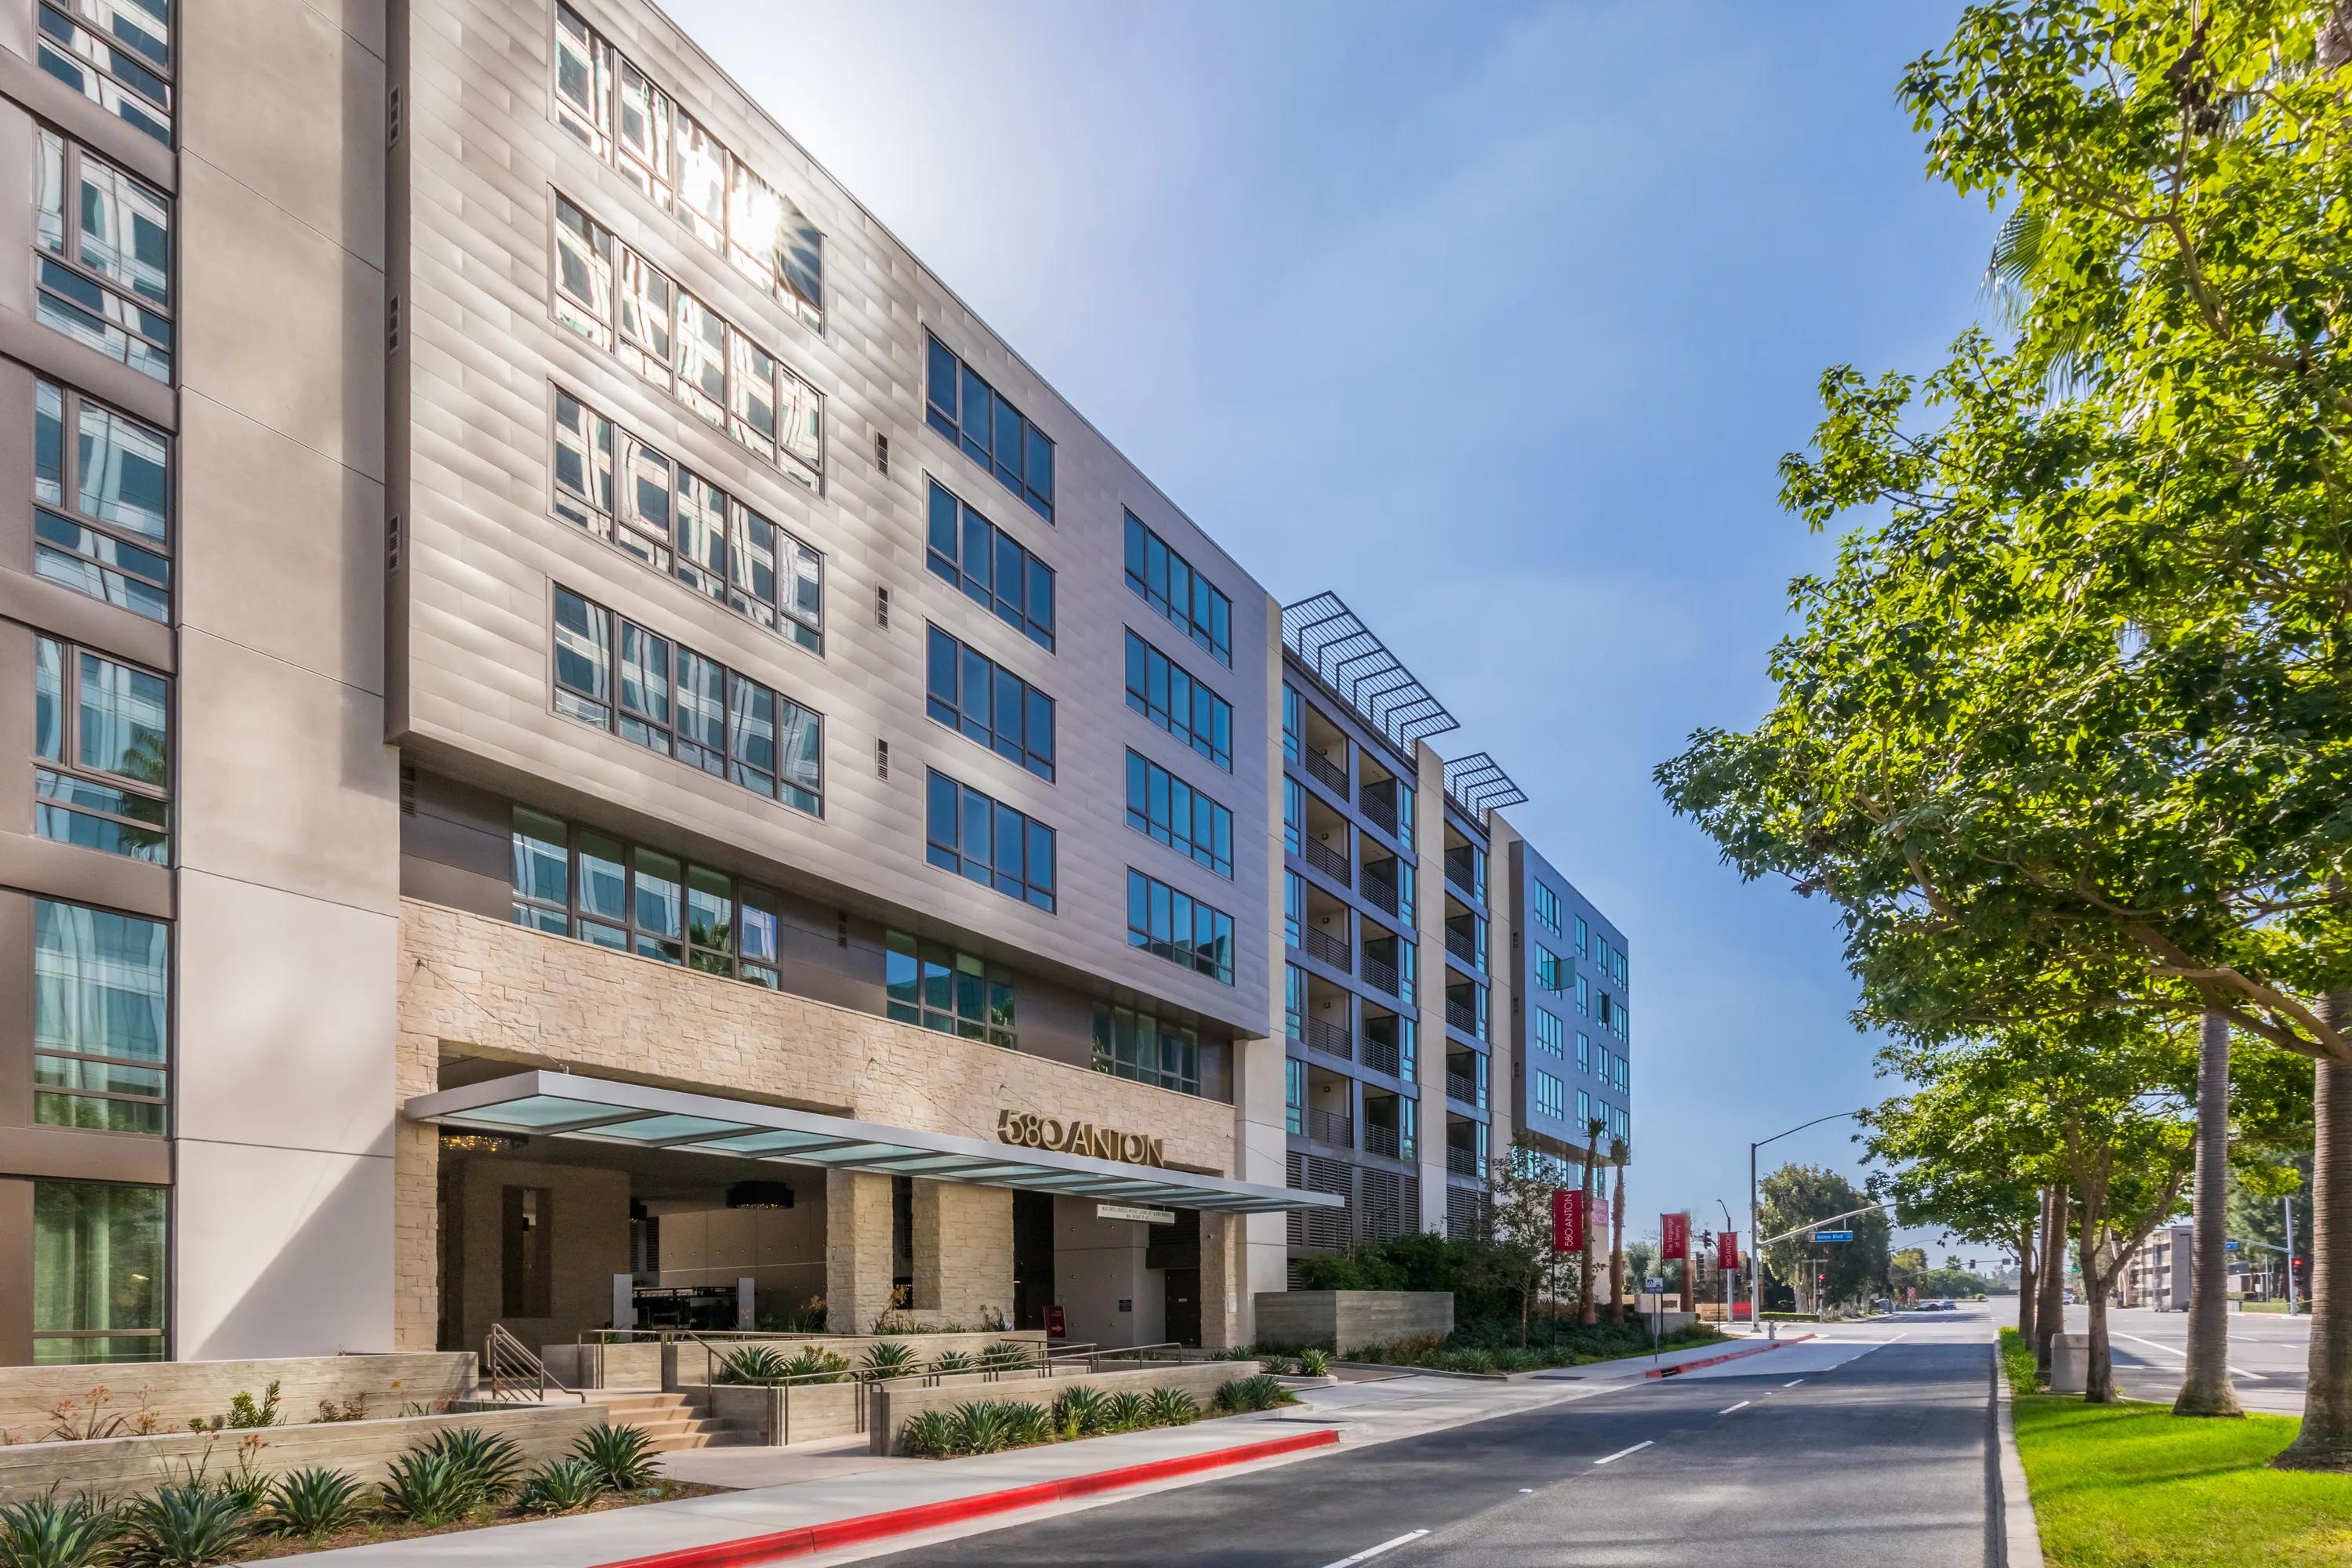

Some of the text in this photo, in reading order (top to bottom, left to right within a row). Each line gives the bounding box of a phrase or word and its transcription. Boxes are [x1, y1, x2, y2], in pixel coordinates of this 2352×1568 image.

[997, 1109, 1164, 1167] 580 ANTON
[1564, 1193, 1573, 1247] 580 ANTON
